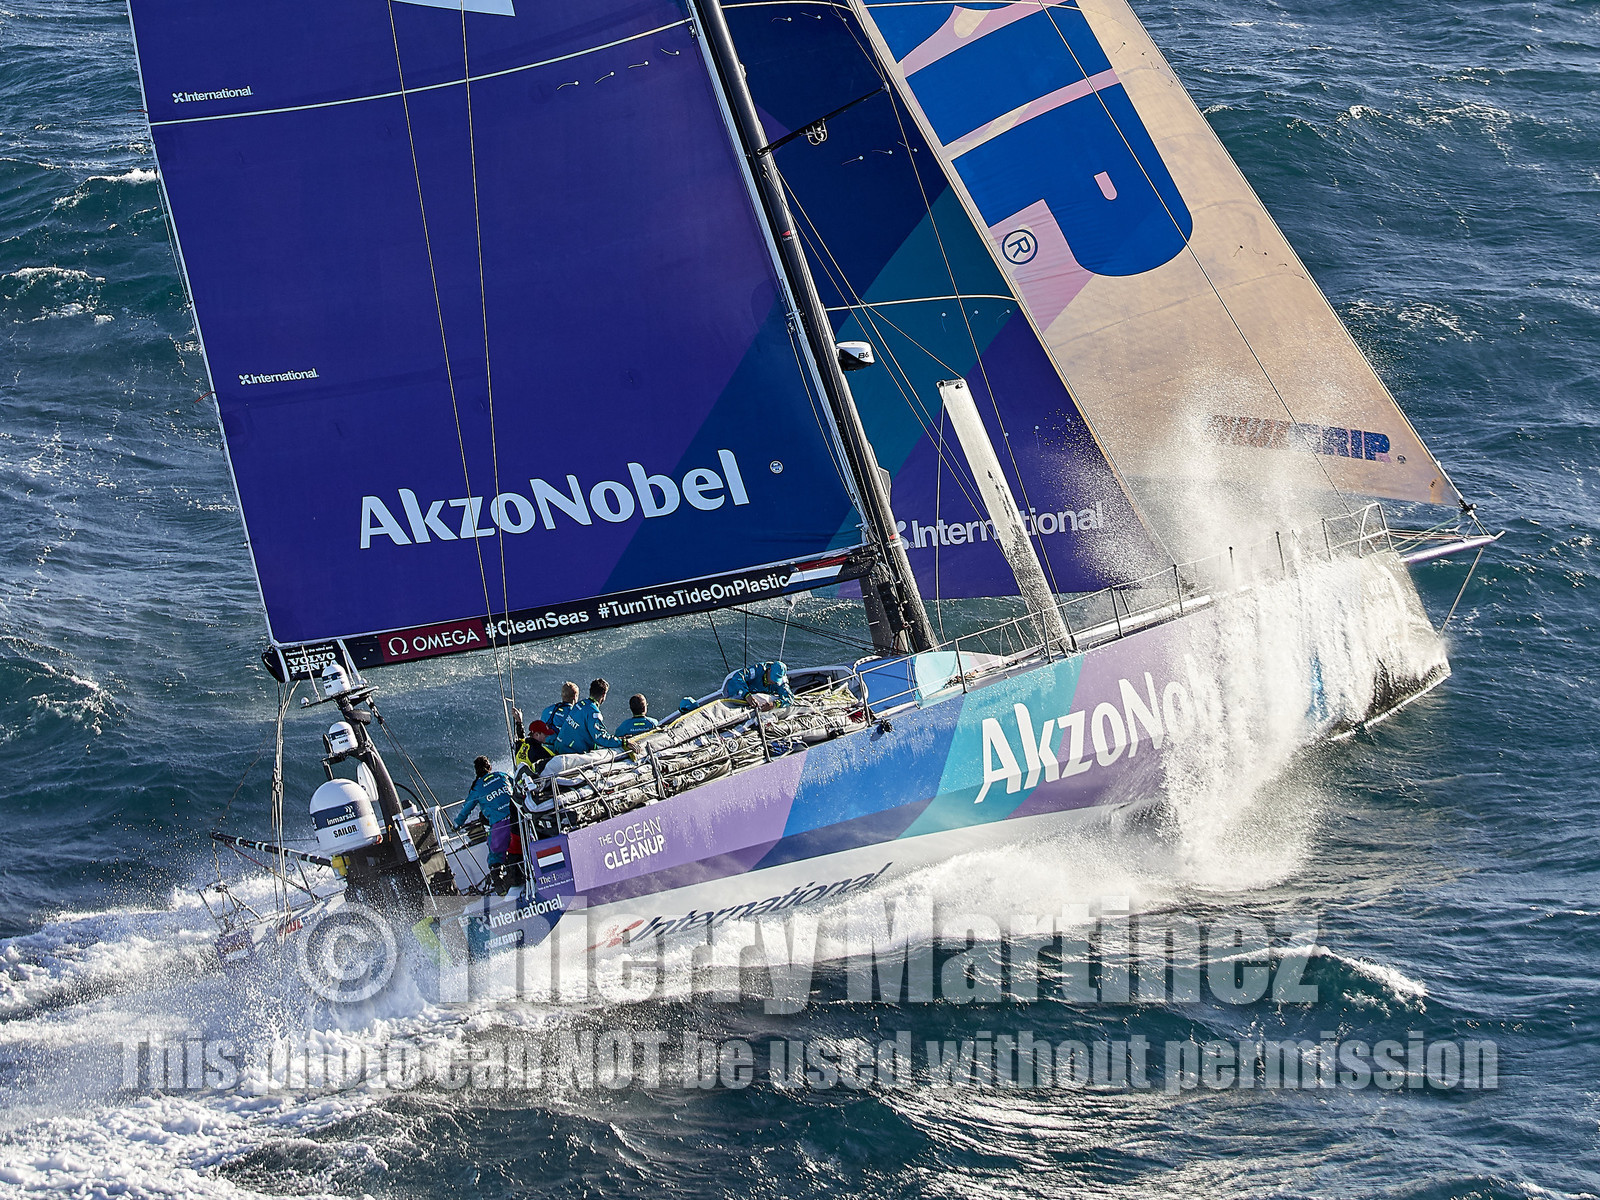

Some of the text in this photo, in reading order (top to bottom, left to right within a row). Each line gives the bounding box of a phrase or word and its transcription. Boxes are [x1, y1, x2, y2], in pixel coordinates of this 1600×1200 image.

[184, 86, 252, 102] International
[250, 368, 318, 384] International
[360, 449, 750, 549] AkzoNobel
[911, 501, 1103, 549] Interntional
[412, 628, 480, 651] OMEGA
[485, 610, 590, 639] #CleanSeas
[598, 572, 790, 619] #TurnTheTideOnPlastic
[288, 652, 336, 666] VOLVO
[333, 824, 358, 839] SAILOR
[598, 817, 662, 847] THE OCEAN
[604, 834, 665, 870] CLEANUP
[538, 875, 551, 885] The
[489, 893, 563, 929] International
[630, 861, 894, 942] International
